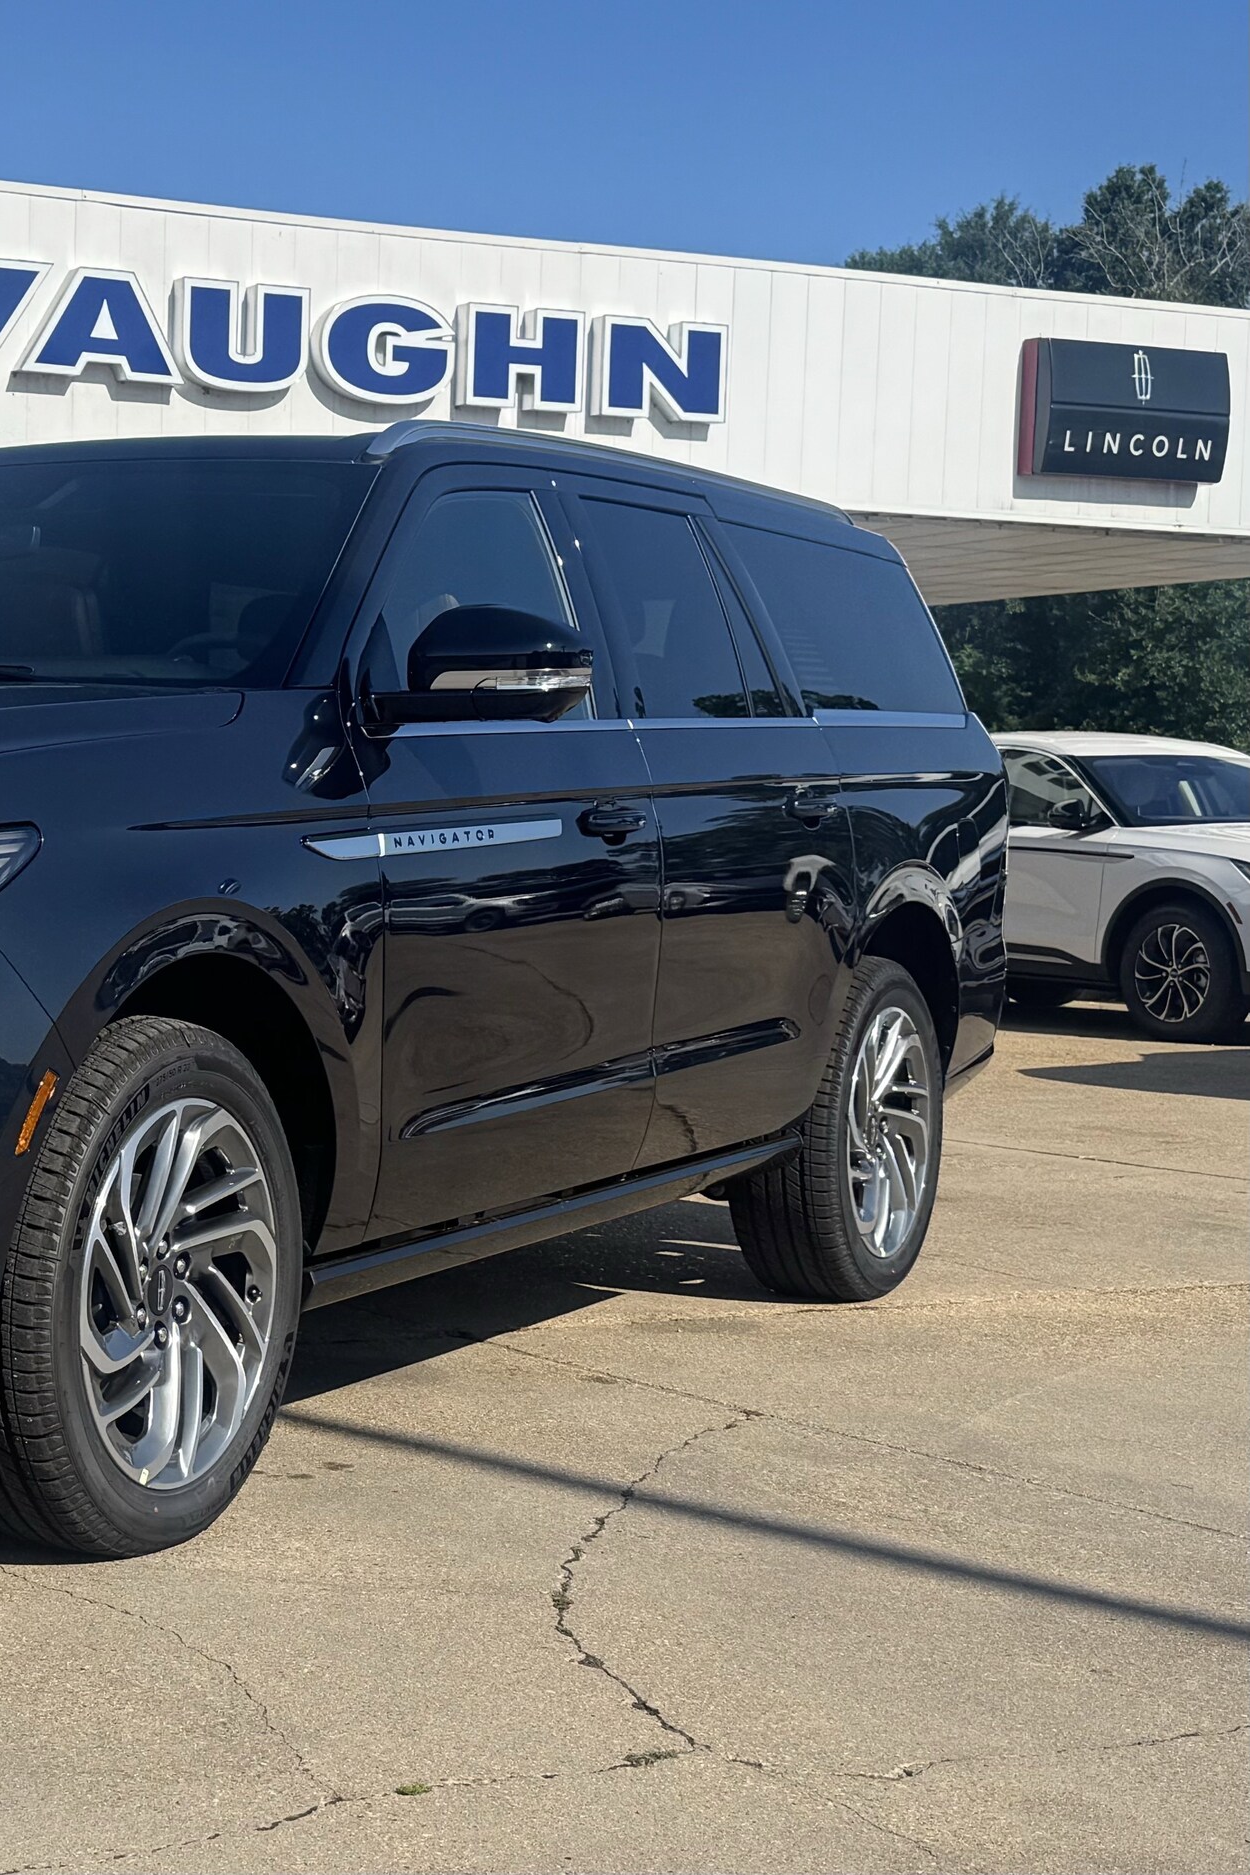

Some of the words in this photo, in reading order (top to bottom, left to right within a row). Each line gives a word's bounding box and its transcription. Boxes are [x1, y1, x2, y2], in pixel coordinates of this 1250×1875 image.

[1063, 430, 1212, 461] LINCOLN
[393, 828, 495, 849] NAVIGATOR
[85, 1087, 148, 1206] MICHELIN
[231, 1370, 287, 1488] MICHELIN
